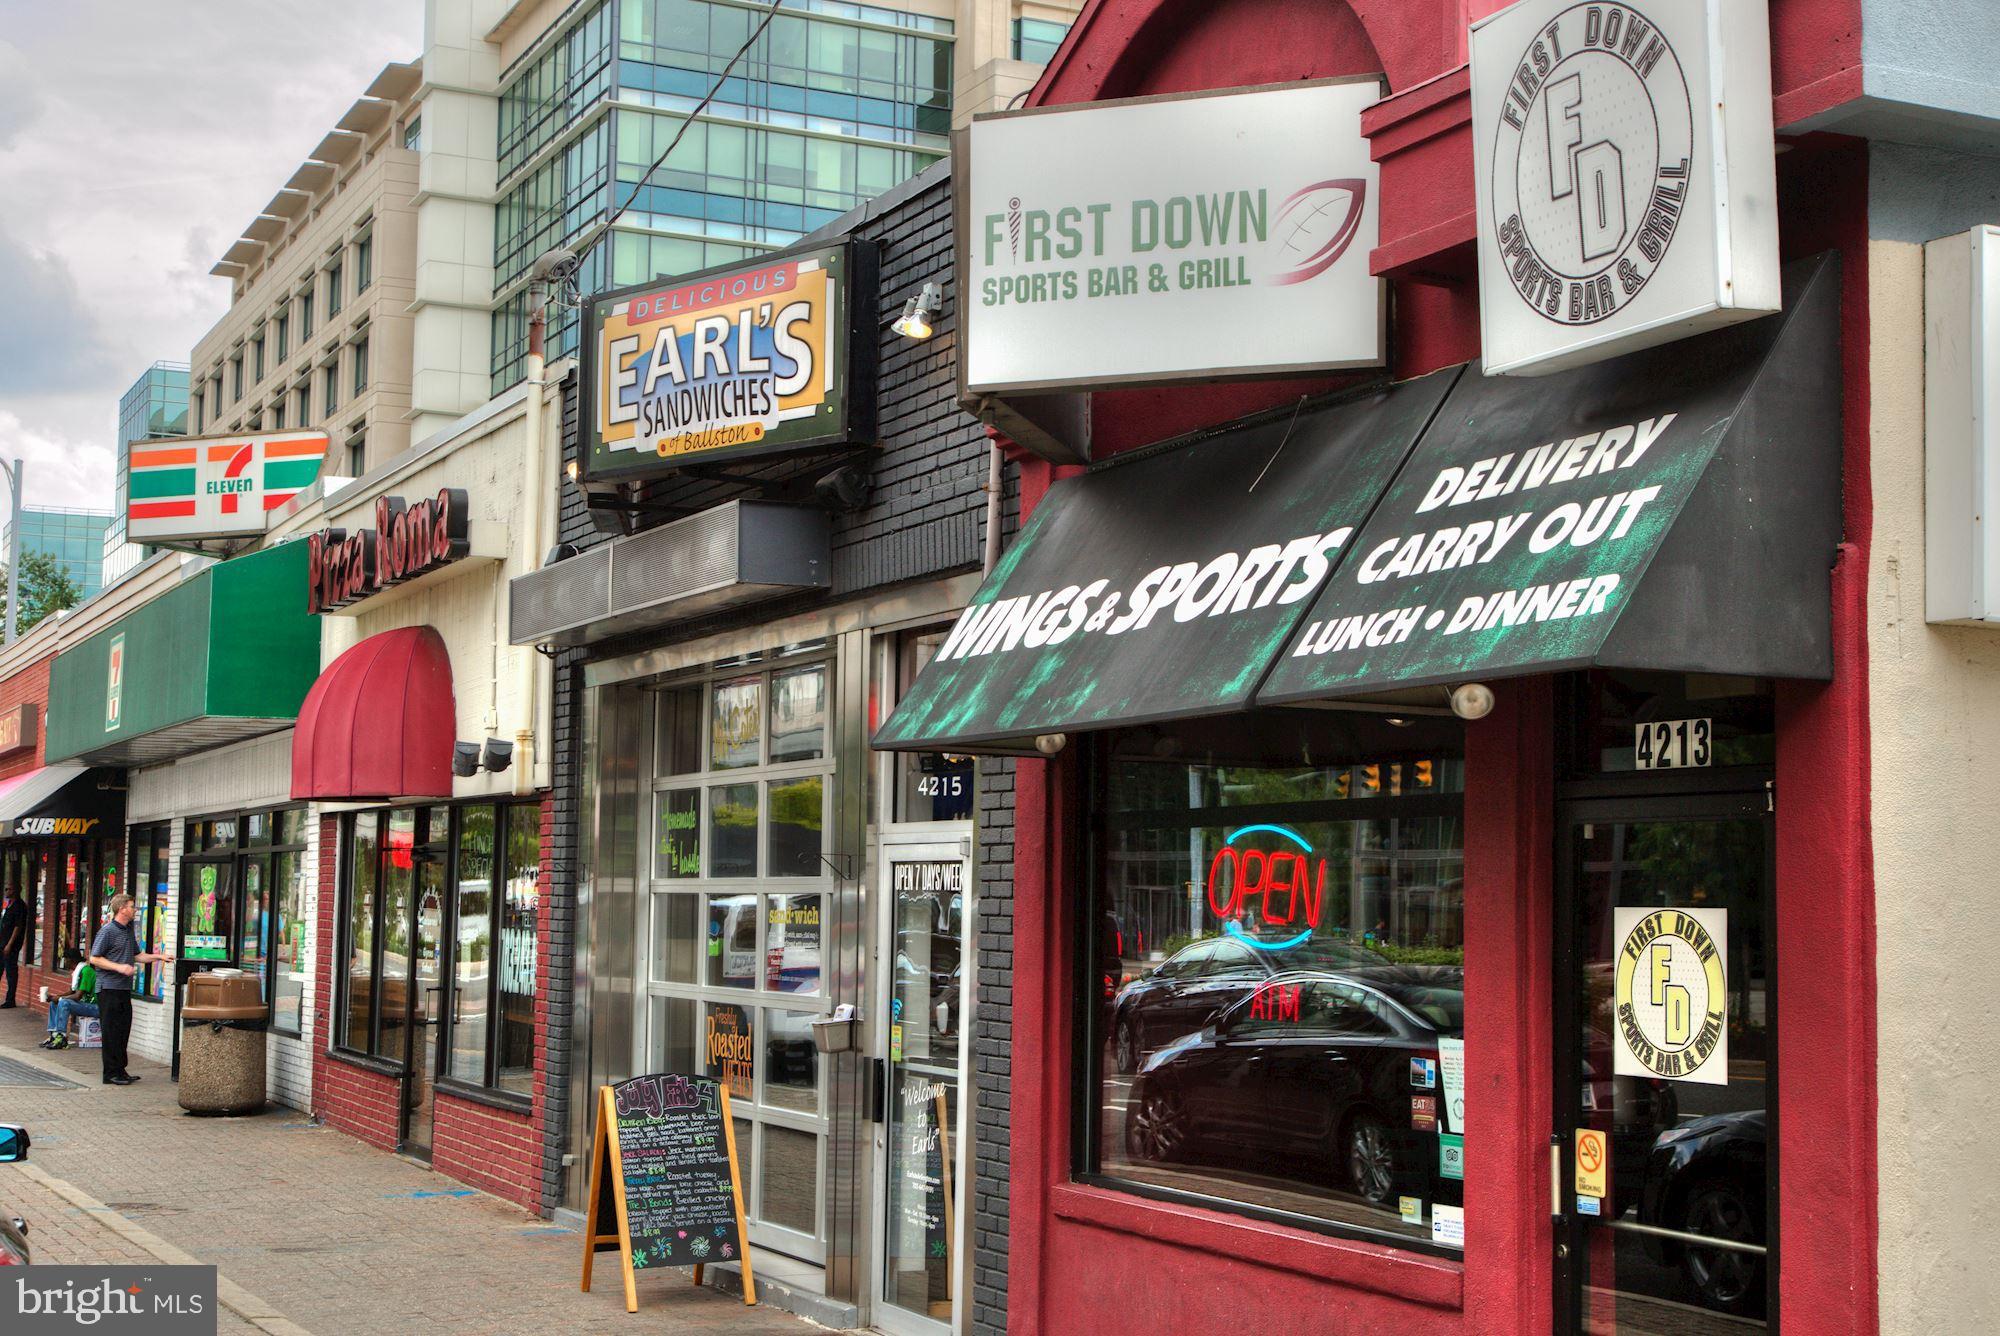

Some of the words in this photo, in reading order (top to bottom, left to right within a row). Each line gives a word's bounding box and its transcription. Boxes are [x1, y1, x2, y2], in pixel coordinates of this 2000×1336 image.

[1503, 22, 1562, 132] FIRST
[1584, 7, 1667, 79] DOWN
[1132, 188, 1267, 253] DOWN
[1500, 213, 1563, 316] SPORTS
[1568, 274, 1616, 321] BAR
[1617, 258, 1645, 295] &
[1636, 158, 1689, 263] GRILL
[635, 269, 787, 319] DELICIOUS
[982, 270, 1078, 307] SPORTS
[1087, 264, 1138, 298] BAR
[1148, 262, 1169, 293] &
[1178, 256, 1252, 291] GRILL
[608, 300, 815, 426] EARL'S
[643, 377, 771, 439] SANDWICHES
[669, 434, 681, 455] of
[683, 422, 750, 452] Ballston
[1414, 412, 1679, 515] DELIVERY
[308, 528, 370, 616] Pizza
[374, 488, 460, 589] Roma
[1355, 509, 1525, 586] CARRY
[1526, 485, 1662, 555] OUT
[934, 579, 1091, 663] WINGS
[1086, 591, 1122, 633] &
[1105, 525, 1355, 638] SPORTS
[1292, 603, 1424, 658] LUNCH
[1442, 574, 1622, 638] DINNER
[1636, 719, 1711, 769] 4213
[917, 775, 963, 797] 4215
[15, 817, 99, 835] SUBWAY
[895, 864, 914, 891] OPEN
[915, 864, 921, 891] 7
[1208, 846, 1327, 928] OPEN
[1624, 913, 1663, 961] FIRST
[1674, 913, 1716, 963] DOWN
[1250, 981, 1300, 1024] ATM
[706, 1016, 753, 1066] Roasted
[1619, 1002, 1654, 1066] SPORTS
[1655, 1051, 1682, 1075] BAR
[1683, 1049, 1698, 1071] &
[1694, 1010, 1723, 1059] GRILL
[696, 1080, 721, 1116] 4
[916, 1112, 928, 1129] to
